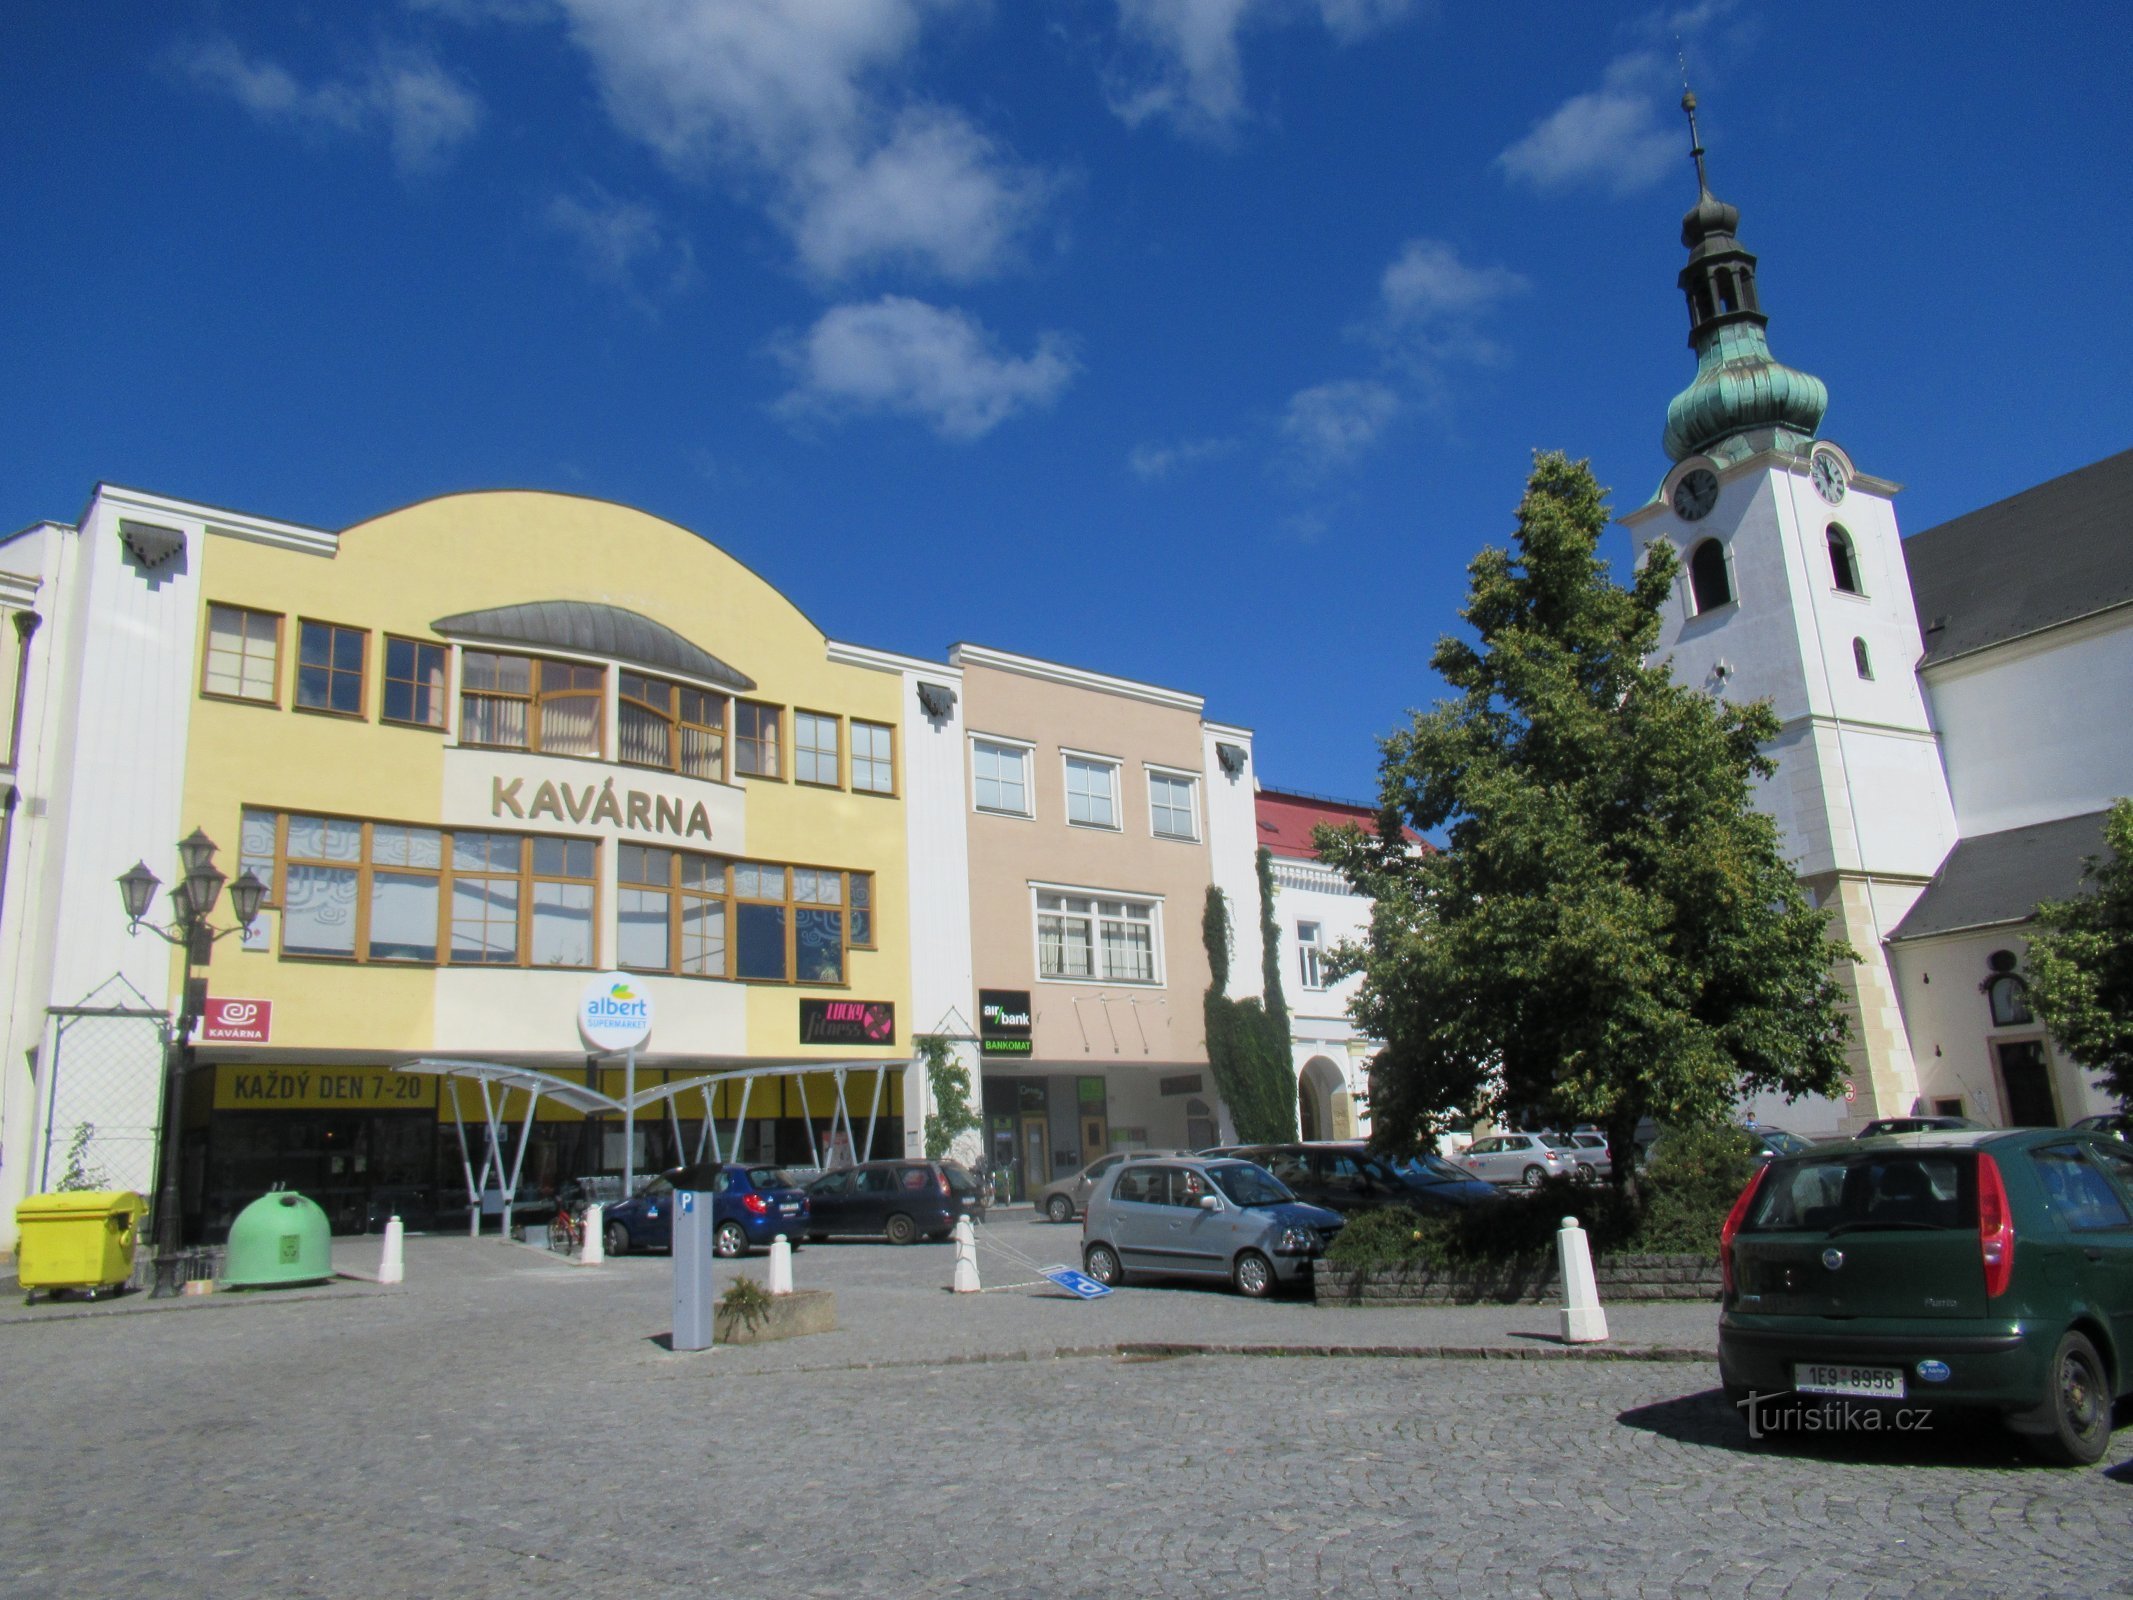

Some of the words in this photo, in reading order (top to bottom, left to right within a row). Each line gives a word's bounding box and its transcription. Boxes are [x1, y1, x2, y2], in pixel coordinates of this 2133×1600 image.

[492, 776, 713, 841] KAVÁRNA
[588, 997, 647, 1016] albert
[826, 1003, 865, 1020] LUCKY
[588, 1019, 646, 1028] SUPERMARKET
[209, 1028, 262, 1038] KAVÁRNA
[985, 1040, 1030, 1050] BANKOMAT
[235, 1070, 310, 1099] KAŽDÝ
[319, 1076, 364, 1099] DEN
[373, 1076, 422, 1099] 7-20
[682, 1192, 692, 1210] P
[1809, 1366, 1838, 1385] 1E9
[1851, 1368, 1895, 1390] 8958
